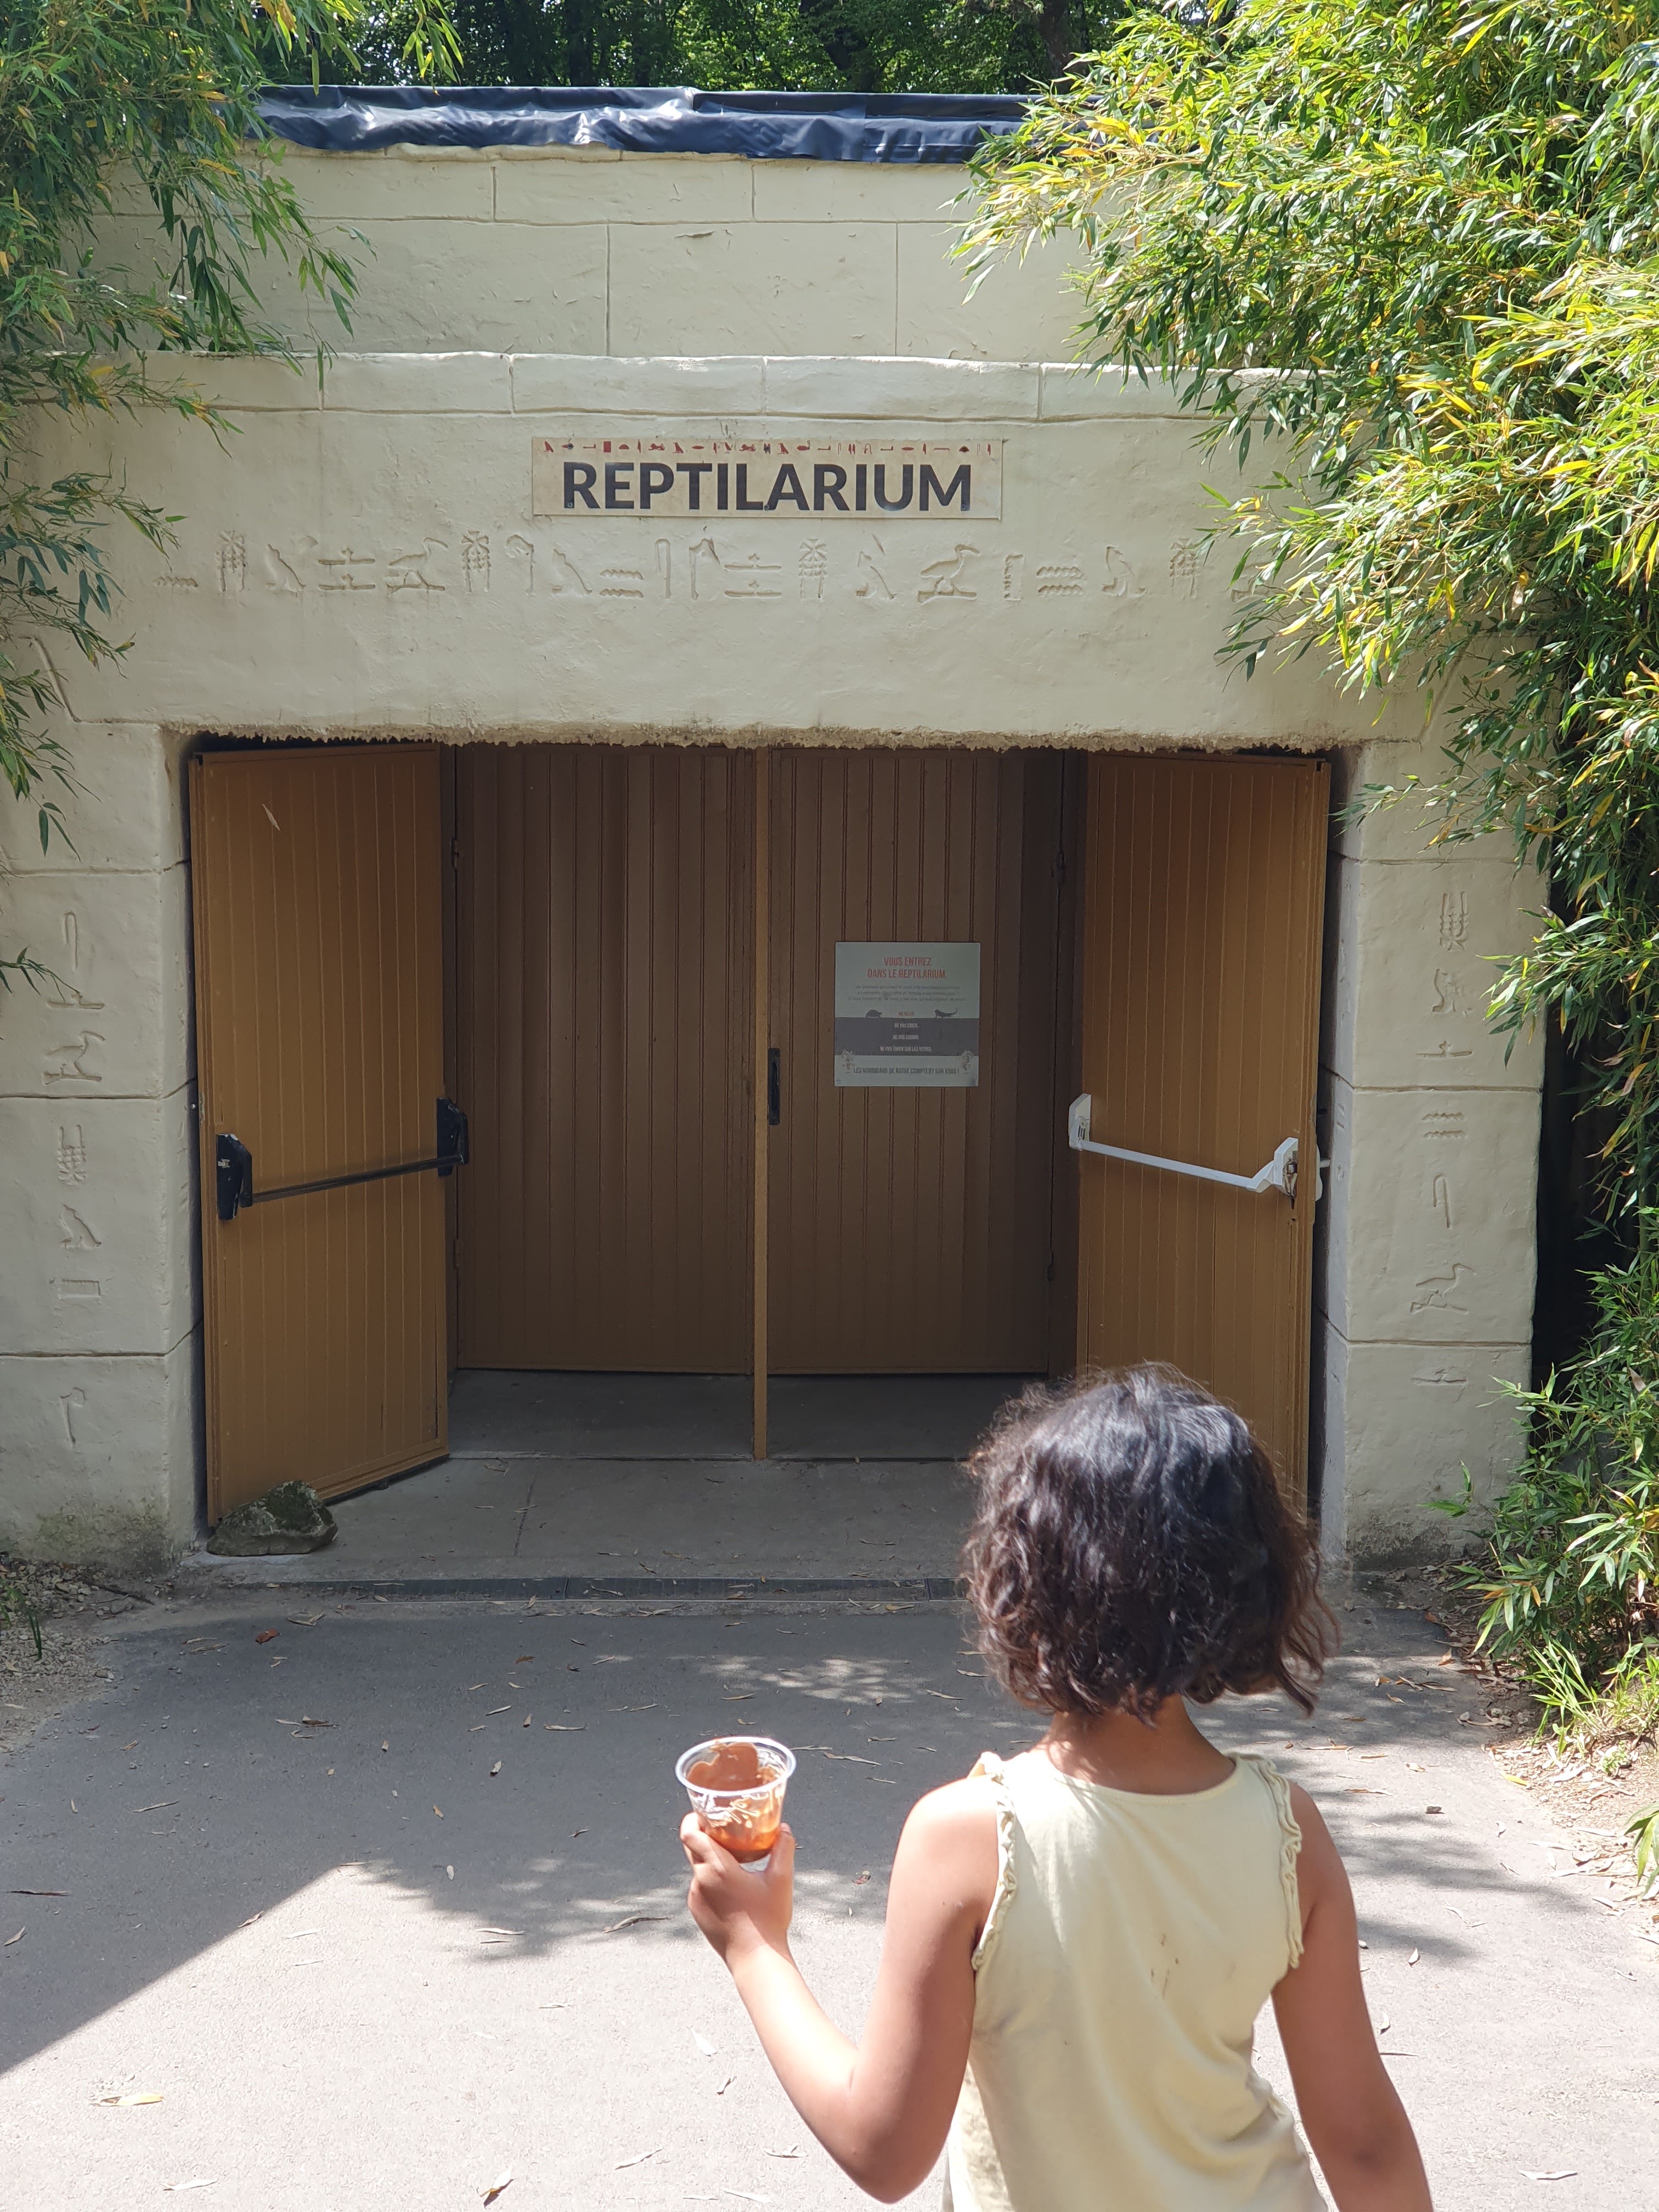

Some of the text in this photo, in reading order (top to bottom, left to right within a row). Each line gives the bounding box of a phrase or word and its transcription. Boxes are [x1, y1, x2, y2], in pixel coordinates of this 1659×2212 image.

[563, 461, 971, 511] REPTILARIUM
[884, 957, 932, 966] VOUS ENTREZ
[867, 969, 946, 979] DANS LE REPTILARIUM
